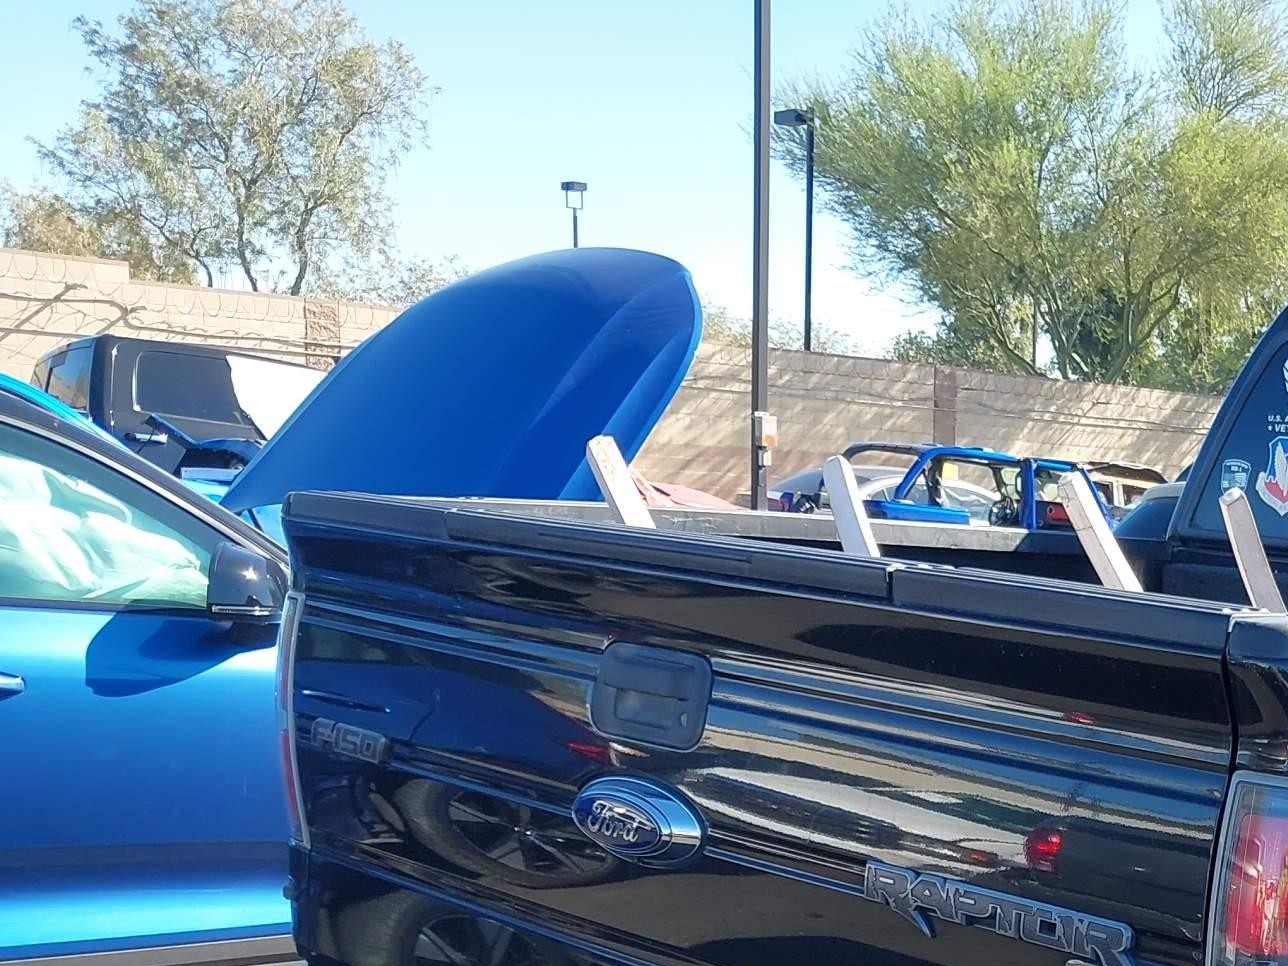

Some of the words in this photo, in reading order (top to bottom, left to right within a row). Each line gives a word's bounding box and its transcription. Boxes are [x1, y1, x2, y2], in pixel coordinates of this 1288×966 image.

[1267, 415, 1283, 423] U.S.
[311, 717, 386, 765] F-150
[587, 799, 647, 842] Ford
